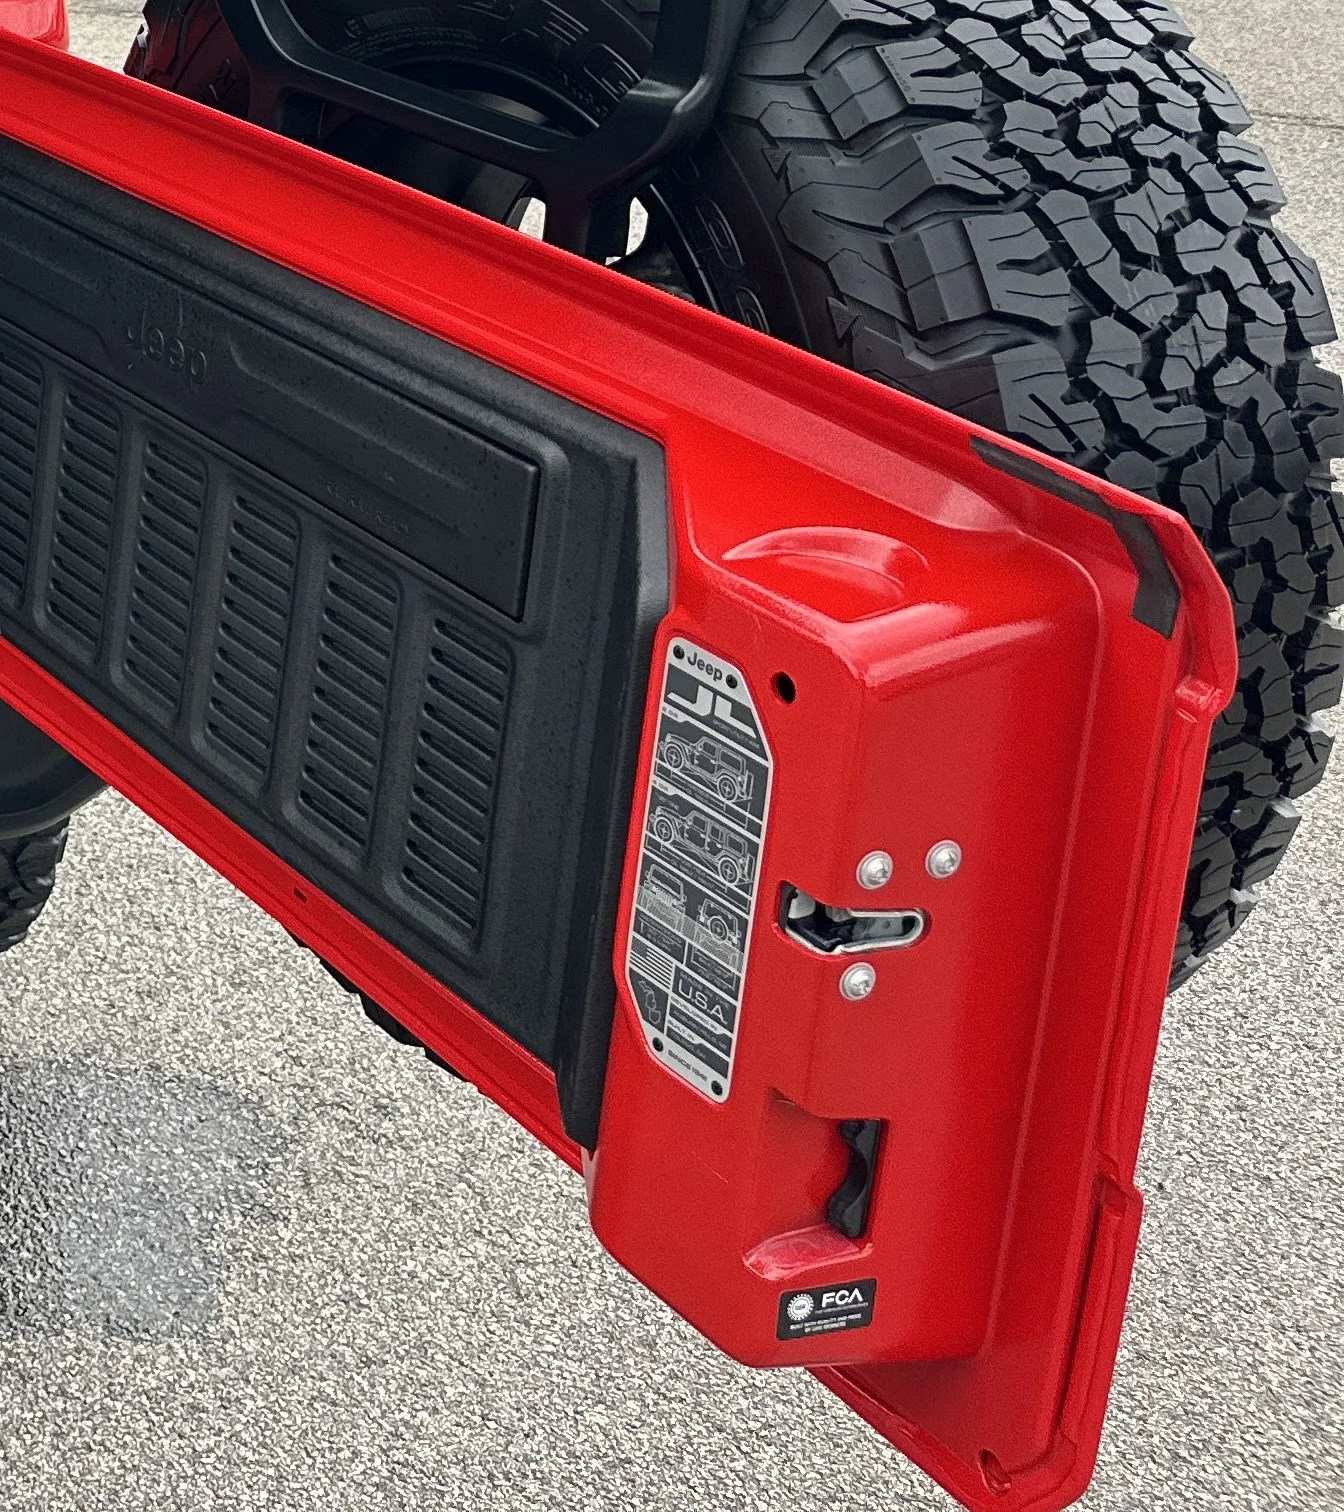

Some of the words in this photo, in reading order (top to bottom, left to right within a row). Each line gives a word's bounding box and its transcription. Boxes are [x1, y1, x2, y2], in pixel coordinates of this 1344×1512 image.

[687, 652, 723, 681] Jeep
[667, 685, 757, 739] JL
[678, 978, 728, 1025] U.S.A.
[821, 1288, 864, 1308] FCA
